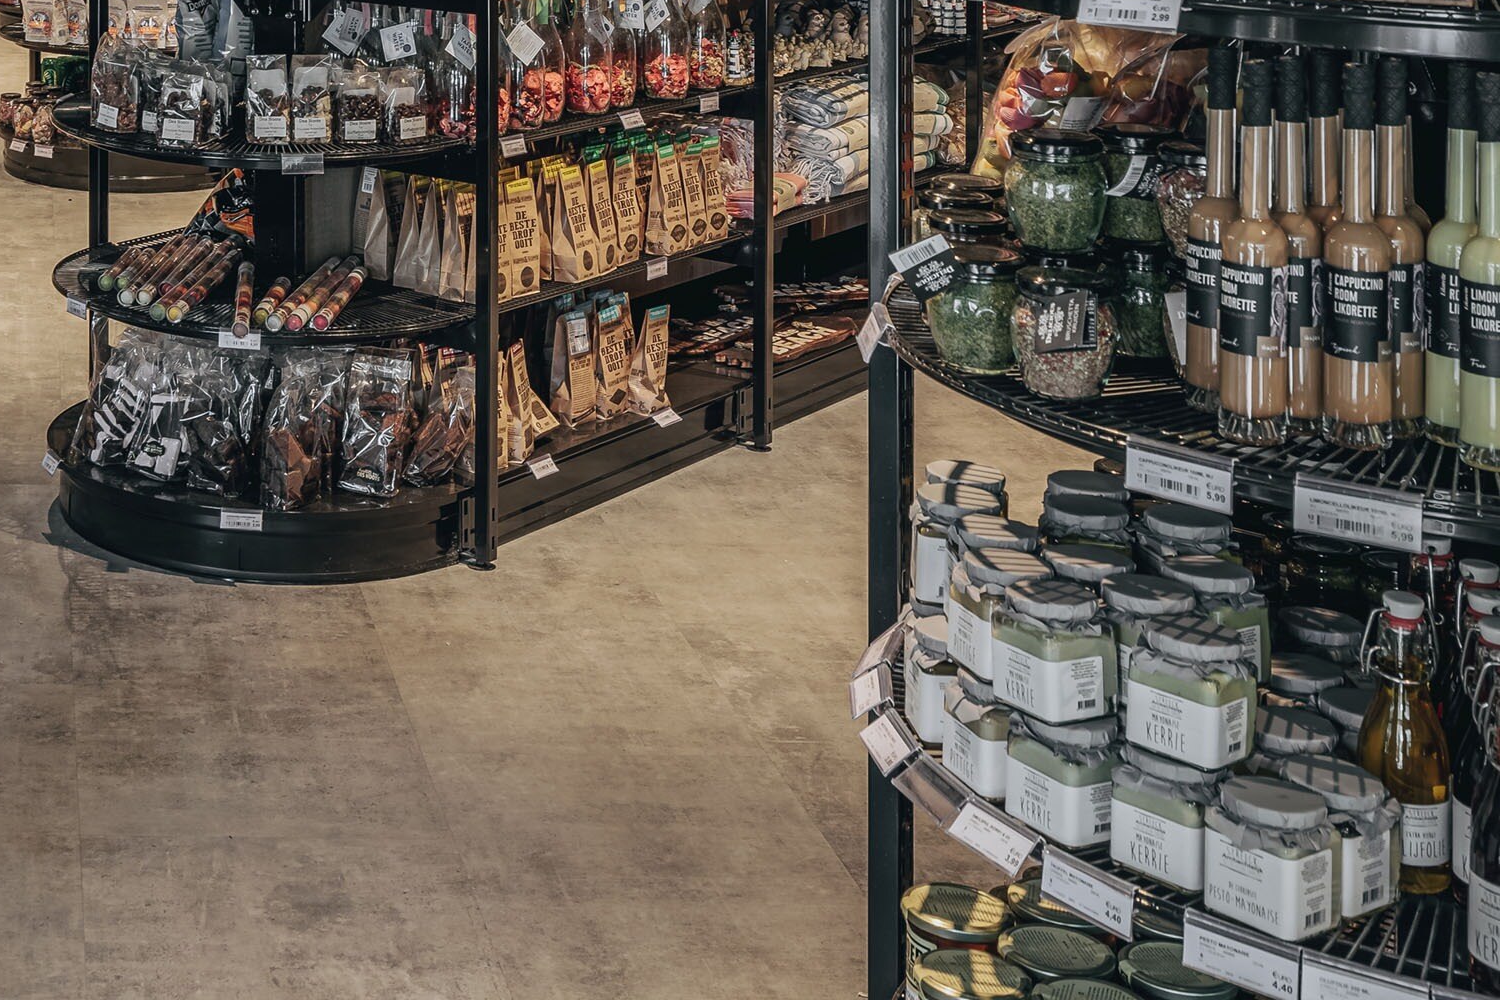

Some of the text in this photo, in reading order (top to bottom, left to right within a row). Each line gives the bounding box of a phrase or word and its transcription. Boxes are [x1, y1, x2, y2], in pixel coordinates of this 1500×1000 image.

[1151, 12, 1170, 22] 2,99
[663, 181, 682, 194] BESTE
[571, 196, 580, 207] DE
[594, 199, 611, 213] BESTE
[515, 210, 528, 221] DE
[568, 203, 588, 218] BESTE
[509, 218, 537, 232] BESTE
[570, 213, 588, 226] DROP
[512, 228, 535, 242] DROP
[573, 222, 588, 235] OOIT
[514, 237, 534, 250] OOIT
[915, 265, 955, 288] DELICIOUS
[1221, 265, 1264, 286] CAPPUCCINO
[1334, 273, 1384, 292] CAPPUCCINO
[1221, 281, 1238, 296] ROOM
[1334, 287, 1358, 304] ROOM
[1220, 294, 1257, 313] LIKORETTE
[1334, 301, 1378, 319] LIKORETTE
[1470, 302, 1496, 318] ROOM
[1045, 302, 1056, 344] DELICIOUS
[1065, 298, 1075, 342] BRUSCHETTA
[606, 334, 617, 345] DE
[652, 333, 662, 344] DE
[772, 325, 838, 355] BEACH
[601, 341, 625, 357] BESTE
[604, 351, 625, 365] DROP
[607, 360, 625, 373] OOIT
[1206, 491, 1226, 503] 5,99
[1391, 531, 1414, 543] 5,99
[1005, 677, 1035, 709] KERRIE
[1145, 721, 1186, 754] KERRIE
[1019, 796, 1051, 830] KERRIE
[1004, 854, 1020, 868] 3,99
[1129, 841, 1170, 875] KERRIE
[1104, 911, 1122, 924] 4,40
[1218, 942, 1250, 958] MAYONAISE
